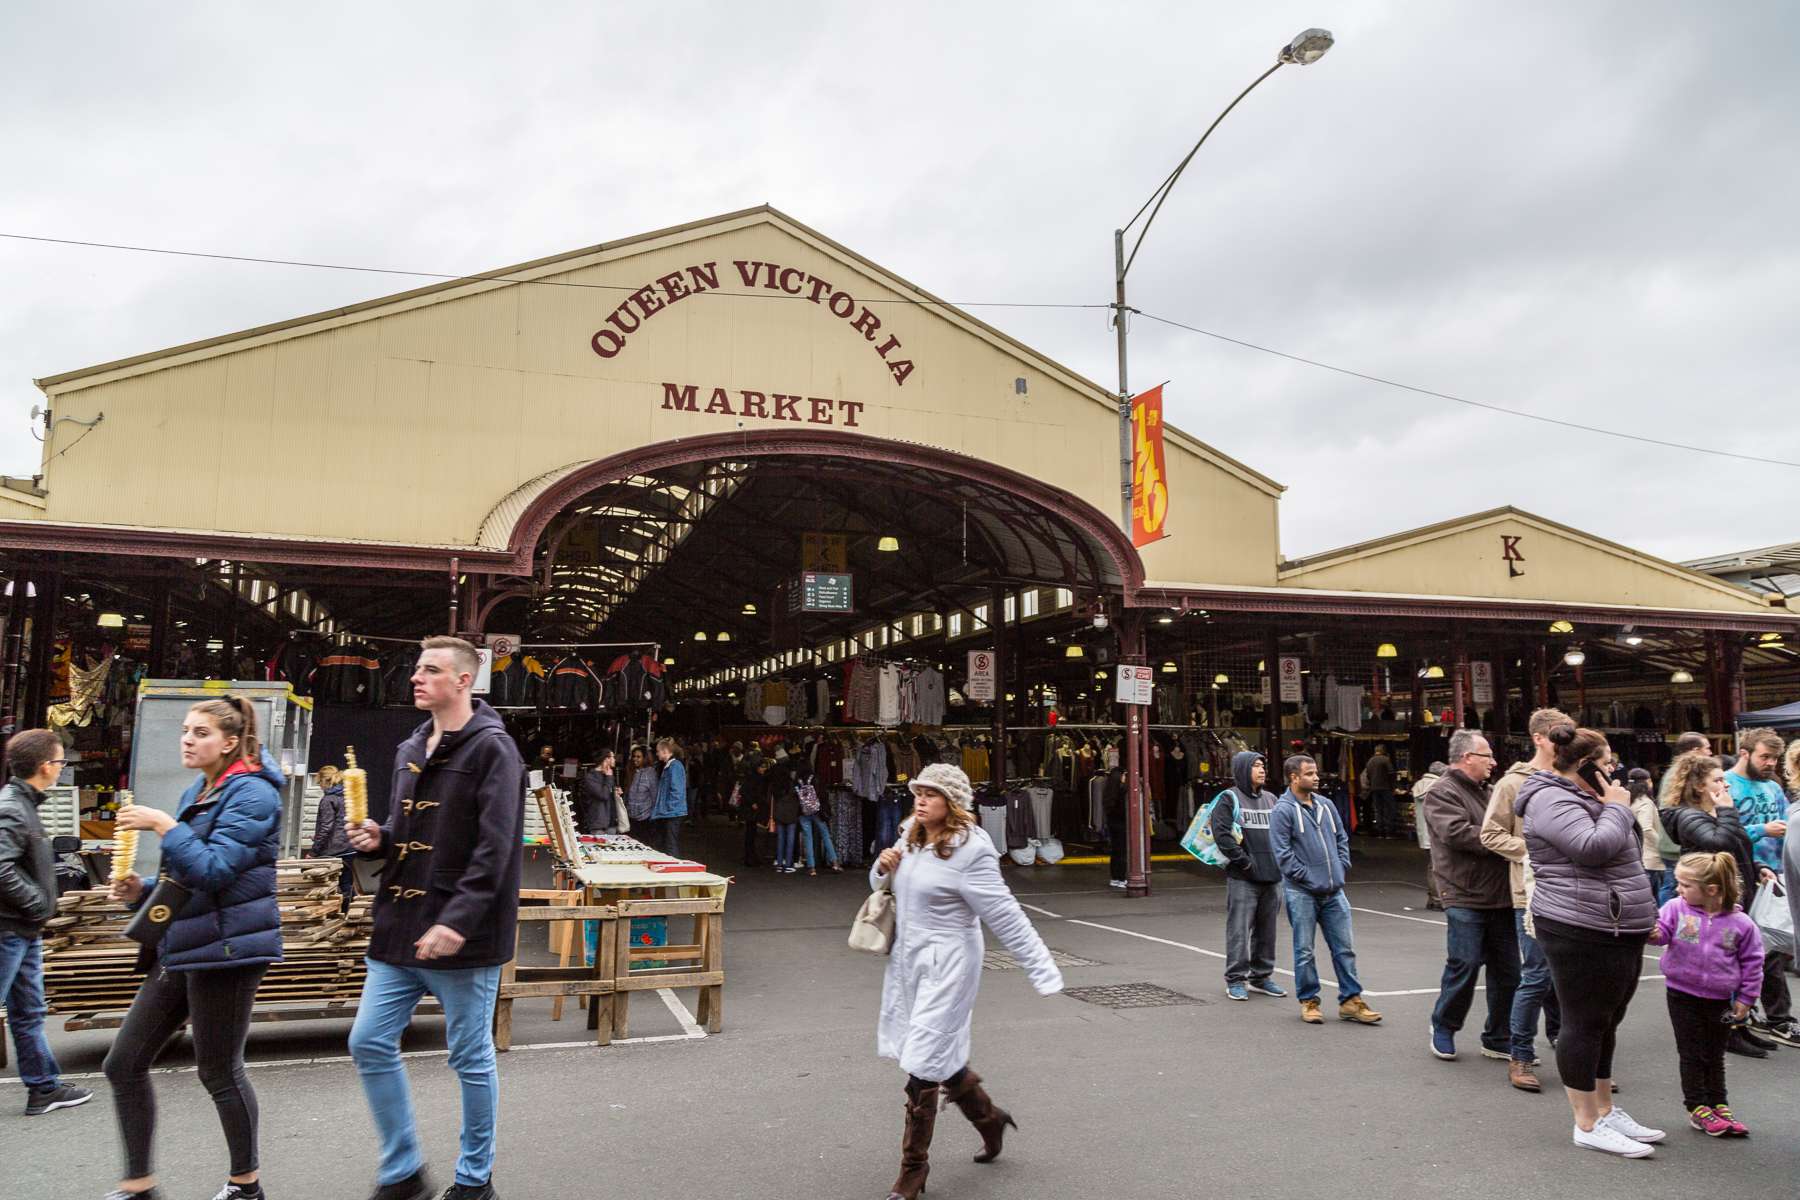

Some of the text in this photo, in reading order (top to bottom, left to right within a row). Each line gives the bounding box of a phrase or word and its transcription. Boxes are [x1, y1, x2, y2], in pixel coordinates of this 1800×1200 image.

[591, 260, 916, 387] QUEEN VICTORIA
[661, 382, 864, 428] MARKET
[1501, 535, 1525, 561] K
[1243, 811, 1271, 825] PUM
